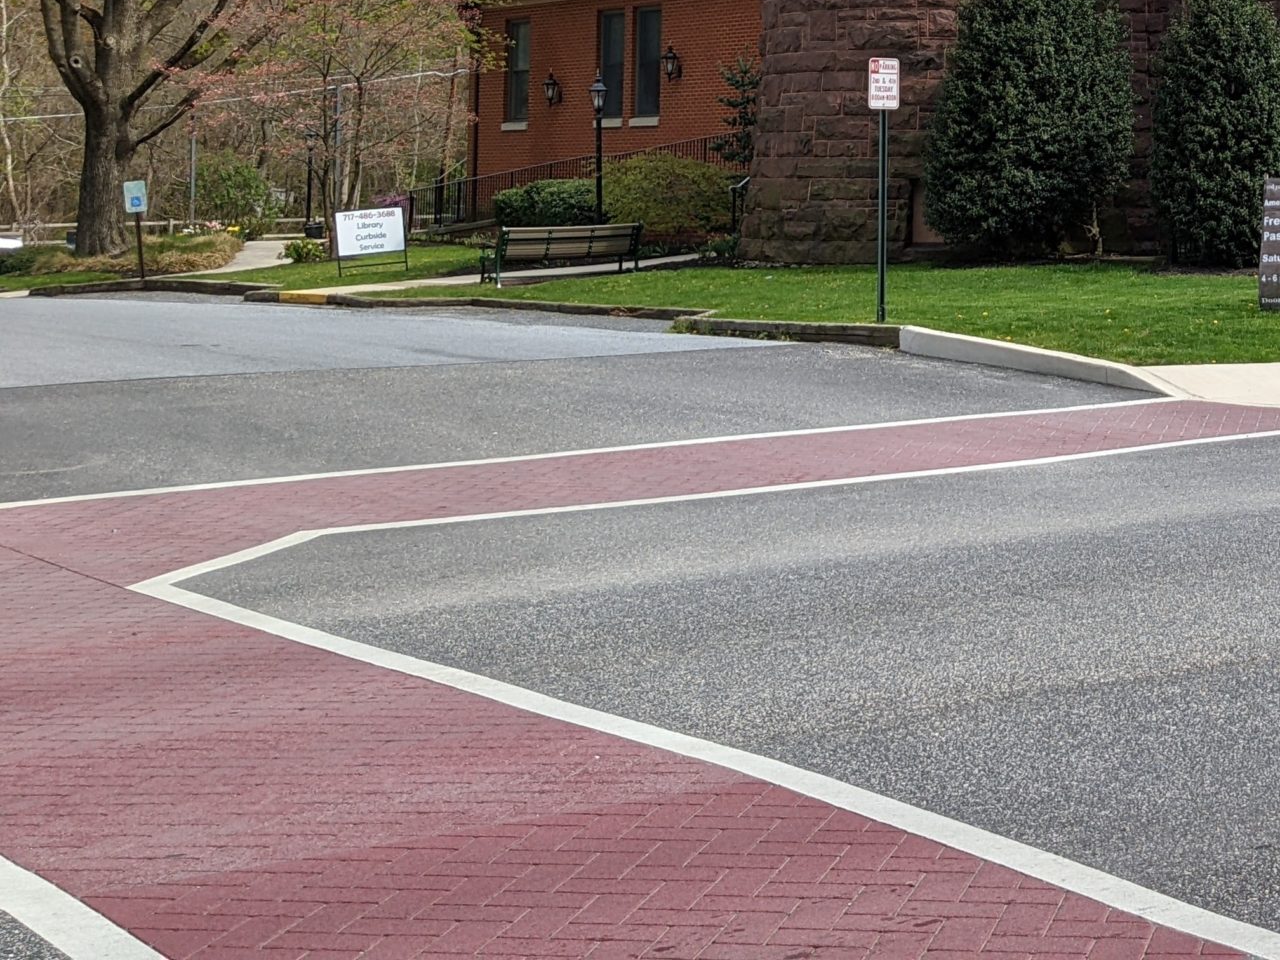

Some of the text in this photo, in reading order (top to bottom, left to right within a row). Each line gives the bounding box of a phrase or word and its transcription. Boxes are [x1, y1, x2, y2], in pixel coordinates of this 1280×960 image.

[356, 222, 383, 230] Library
[355, 231, 387, 241] Curbside
[359, 242, 385, 251] Service
[1261, 273, 1266, 282] 4
[1272, 273, 1278, 282] 6
[1261, 296, 1280, 304] Door
